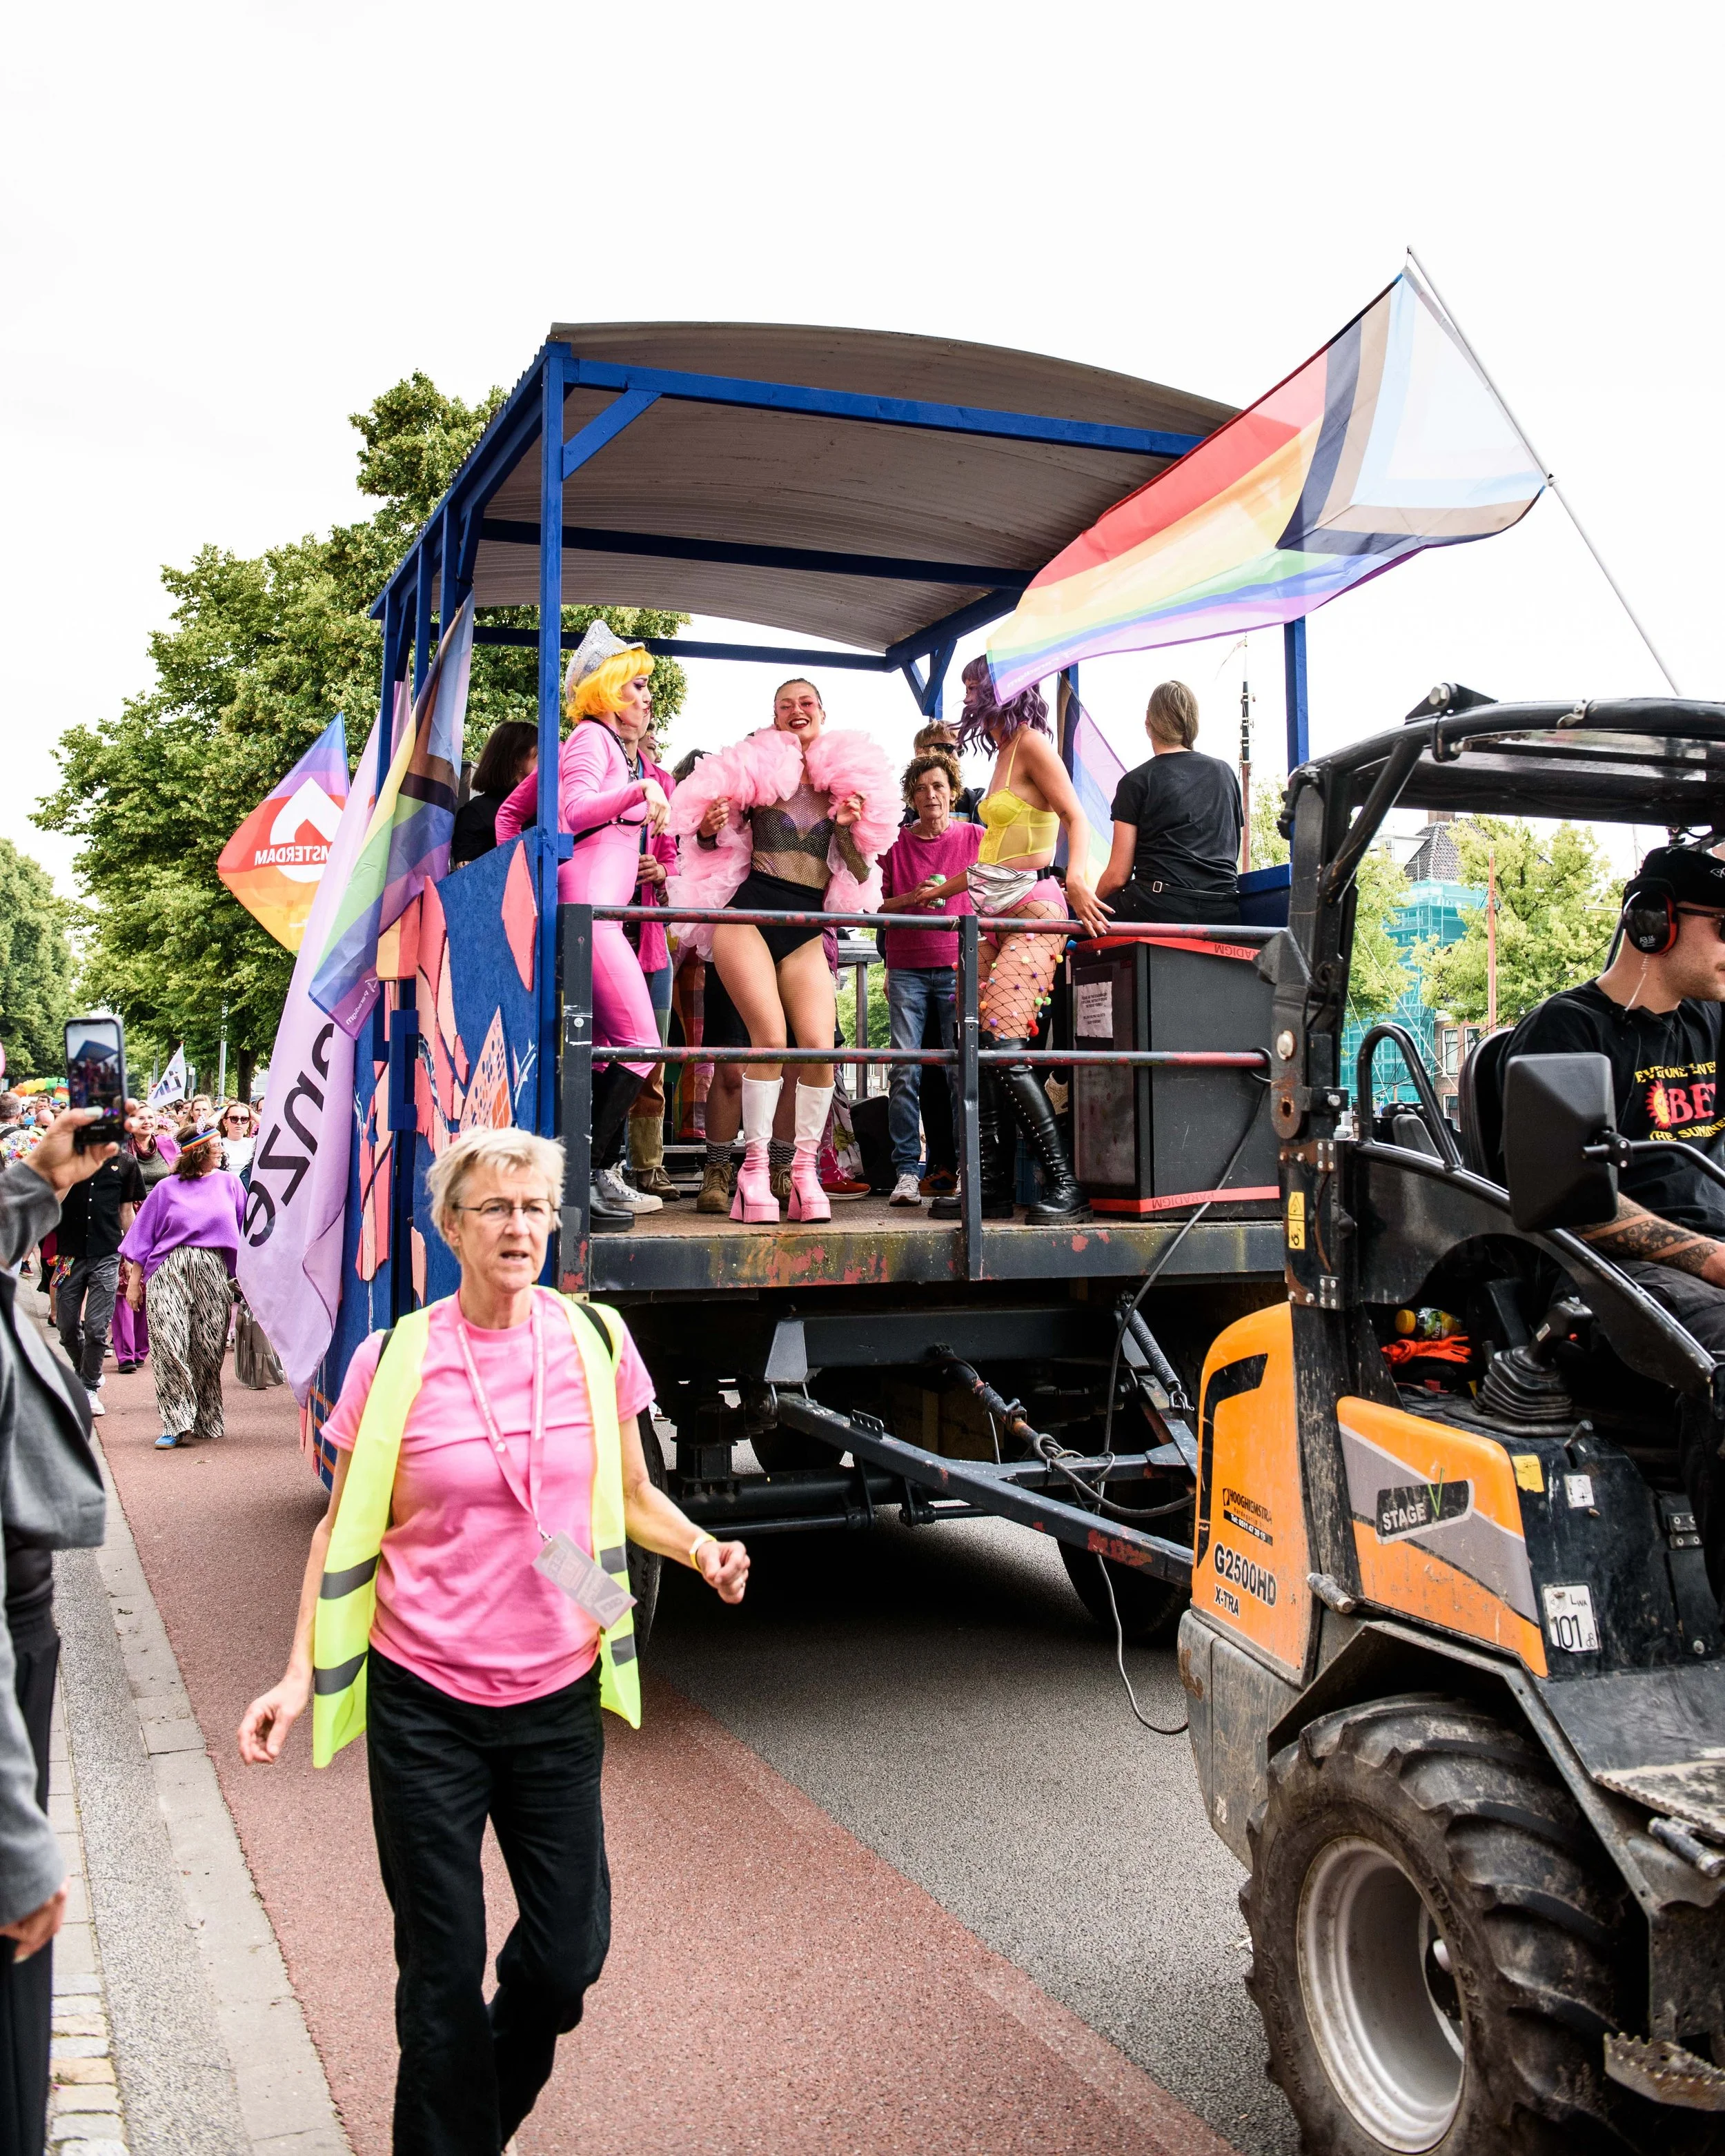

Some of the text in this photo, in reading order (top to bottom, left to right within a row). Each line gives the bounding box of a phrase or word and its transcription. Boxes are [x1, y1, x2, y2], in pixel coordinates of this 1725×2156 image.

[1677, 1117, 1725, 1138] SUNNE
[1152, 1191, 1215, 1209] PARADIGM
[1382, 1503, 1427, 1531] STAGE
[1214, 1543, 1276, 1606] G2500HD
[1215, 1585, 1239, 1616] X-TRA
[1550, 1614, 1582, 1648] 101
